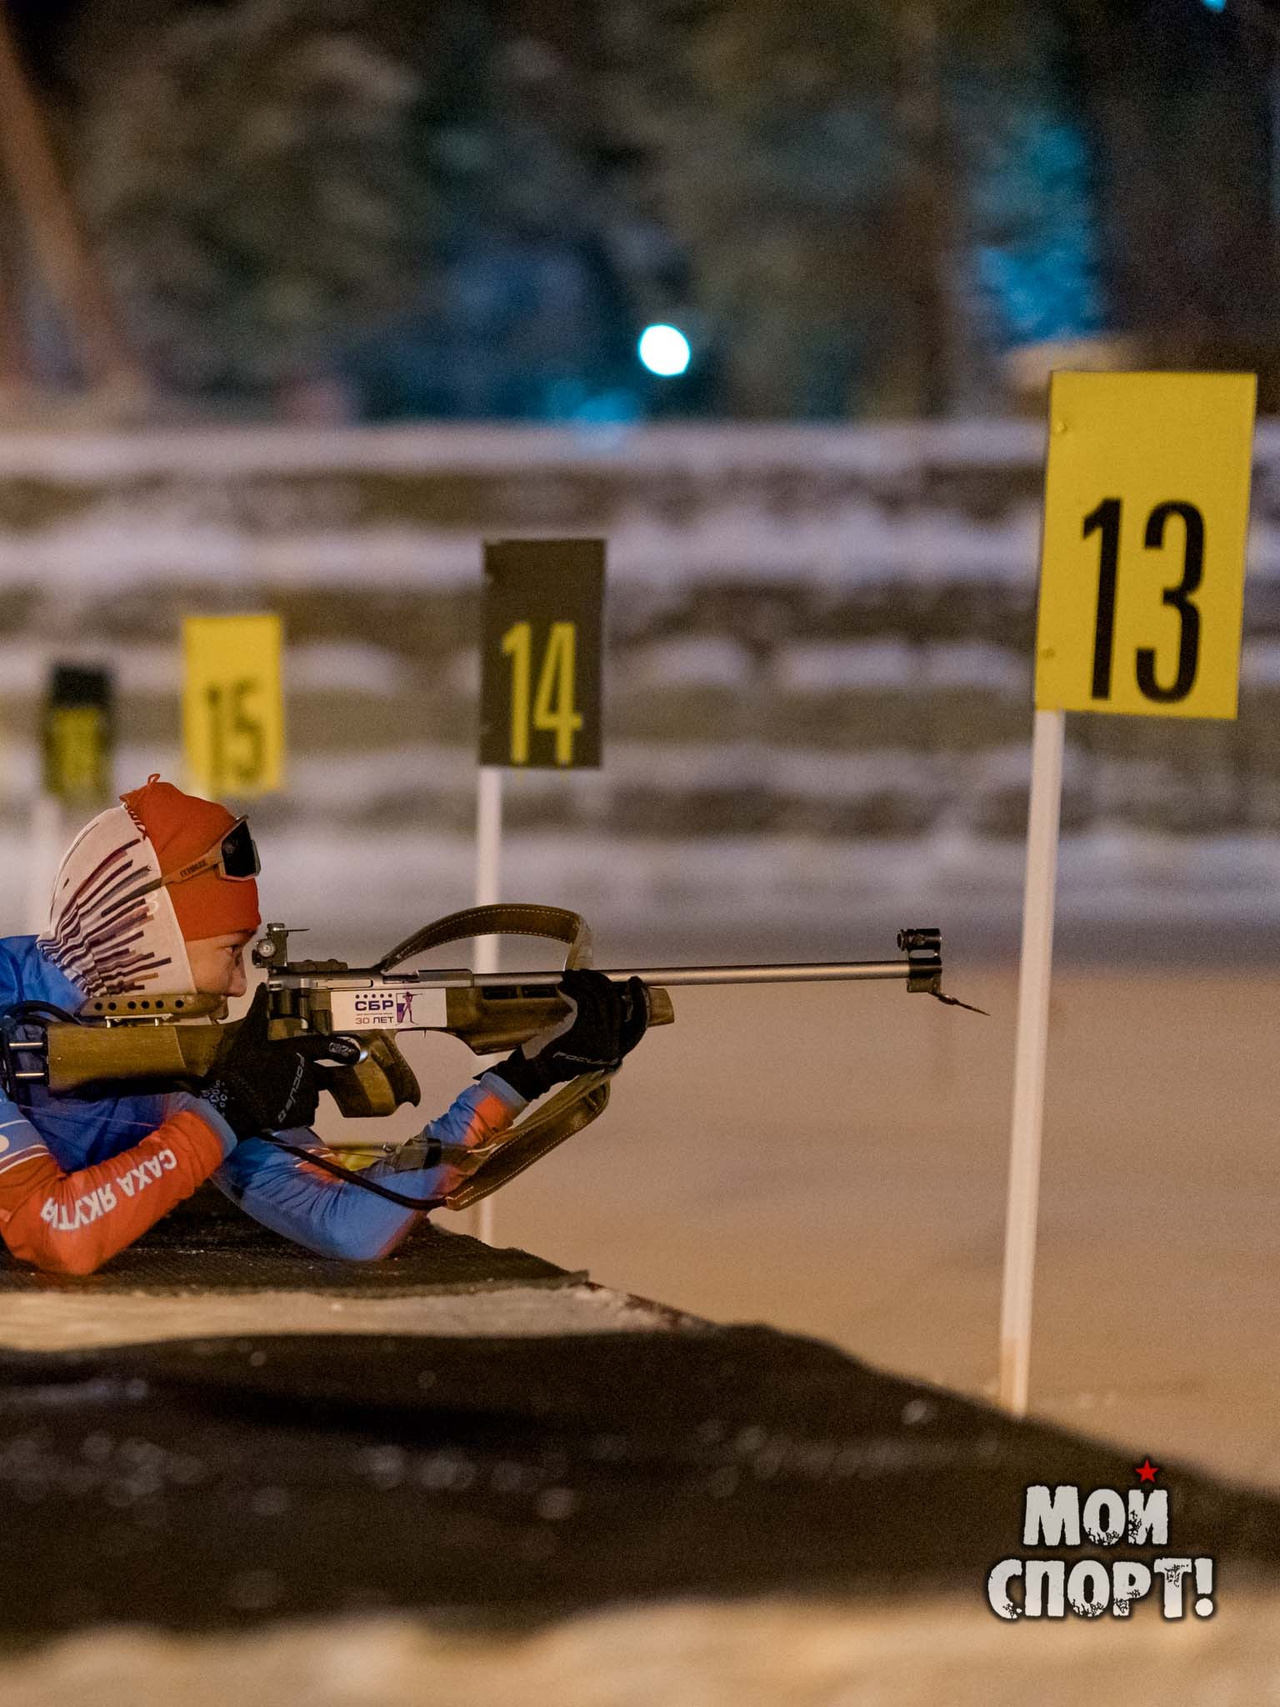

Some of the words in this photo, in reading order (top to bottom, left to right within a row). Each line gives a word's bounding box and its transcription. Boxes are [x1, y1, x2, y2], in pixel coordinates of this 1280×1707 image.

[1082, 497, 1206, 704] 13
[501, 620, 584, 765] 14
[205, 678, 267, 799] 15
[354, 1000, 394, 1011] СБР
[355, 1017, 370, 1025] 30
[372, 1016, 394, 1024] ЛЕТ
[115, 1148, 178, 1198] САХА
